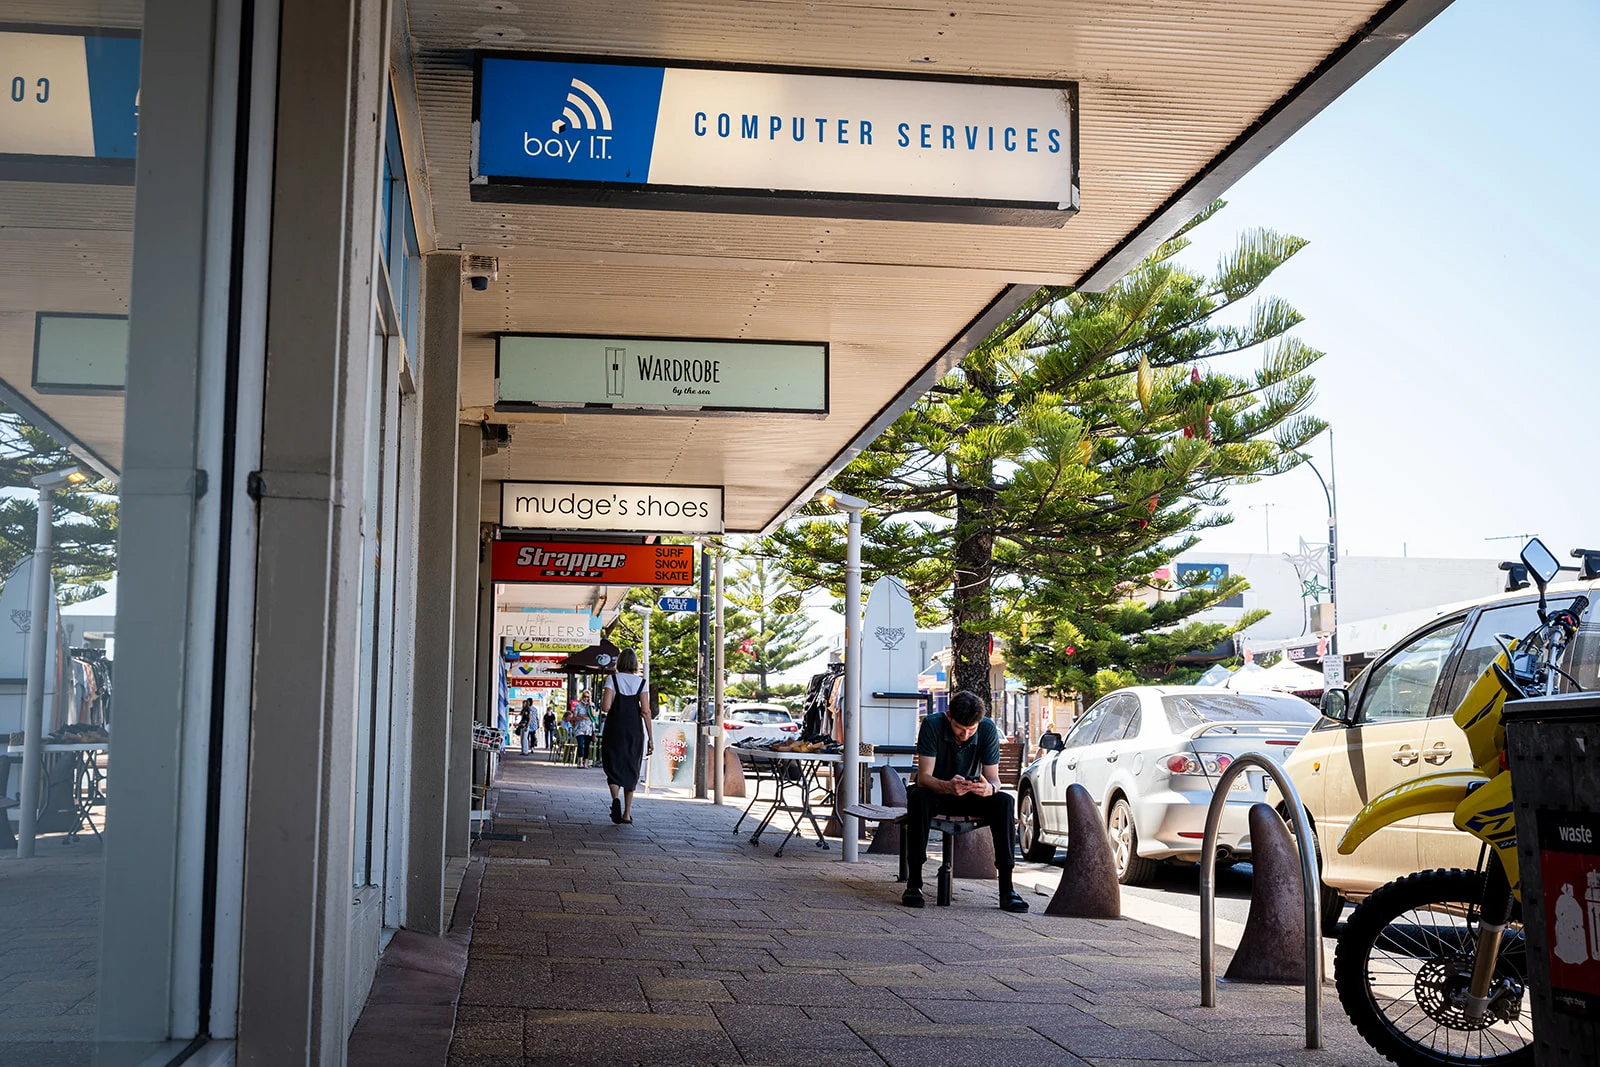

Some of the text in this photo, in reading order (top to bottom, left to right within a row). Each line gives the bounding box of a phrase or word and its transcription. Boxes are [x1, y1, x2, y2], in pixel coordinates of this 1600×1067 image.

[694, 111, 1063, 154] COMPUTER SERVICES
[523, 131, 613, 163] bay I.T.
[672, 386, 712, 396] by the sea
[515, 492, 709, 520] mudge's shoes
[516, 546, 626, 571] Strapper
[655, 547, 684, 558] SURF
[655, 559, 689, 570] SNOW
[655, 570, 689, 581] SKATE
[498, 625, 584, 637] JEWELLERS
[1558, 824, 1593, 844] waste
